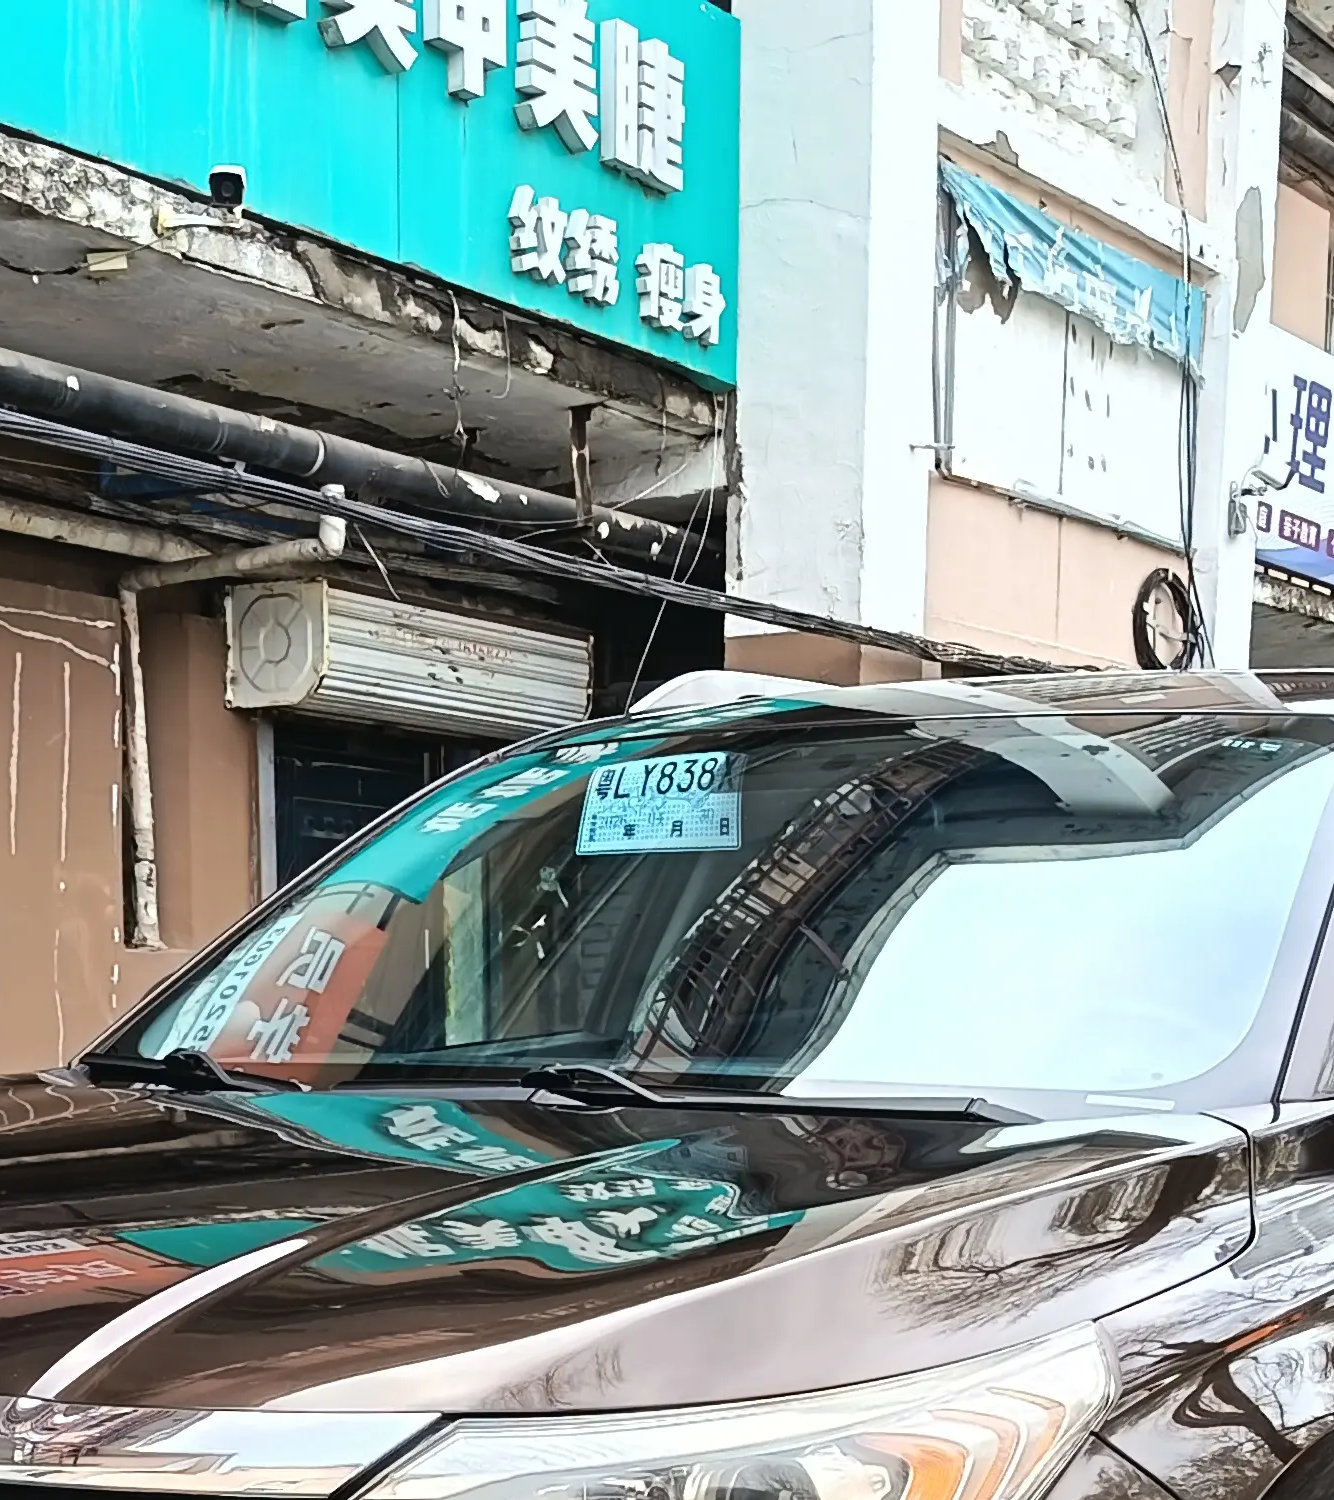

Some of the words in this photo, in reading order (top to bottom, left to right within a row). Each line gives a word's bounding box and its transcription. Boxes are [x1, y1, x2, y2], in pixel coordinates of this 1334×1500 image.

[250, 0, 685, 196] 甲美睫
[508, 184, 619, 306] 纹绣
[635, 242, 726, 346] 瘦身
